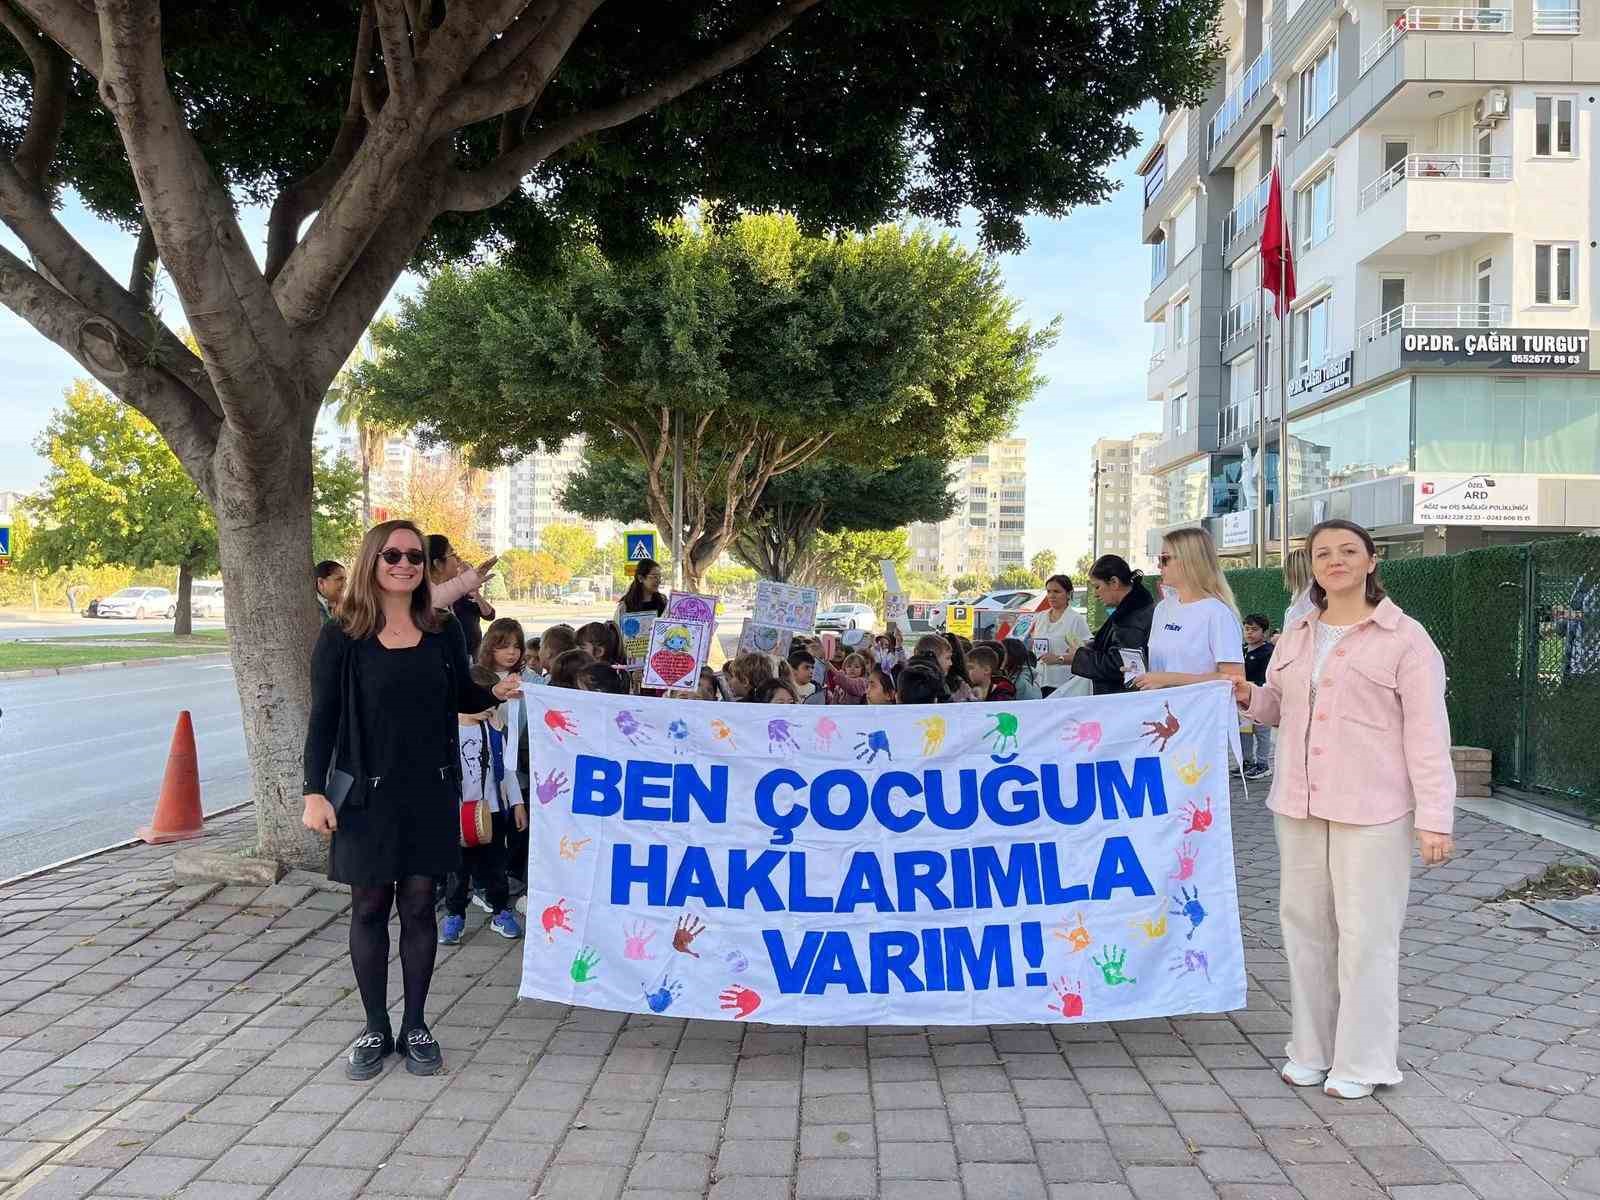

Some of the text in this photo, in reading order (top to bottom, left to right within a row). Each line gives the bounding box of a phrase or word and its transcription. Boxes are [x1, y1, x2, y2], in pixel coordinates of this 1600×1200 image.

[1404, 331, 1589, 356] OP.DR. ÇAĞRI TURGUT
[1464, 491, 1489, 500] ARD
[572, 752, 1168, 845] BEN ÇOCUĞUM
[611, 836, 1155, 913] HAKLARIMLA
[762, 921, 1047, 997] VARIM!
